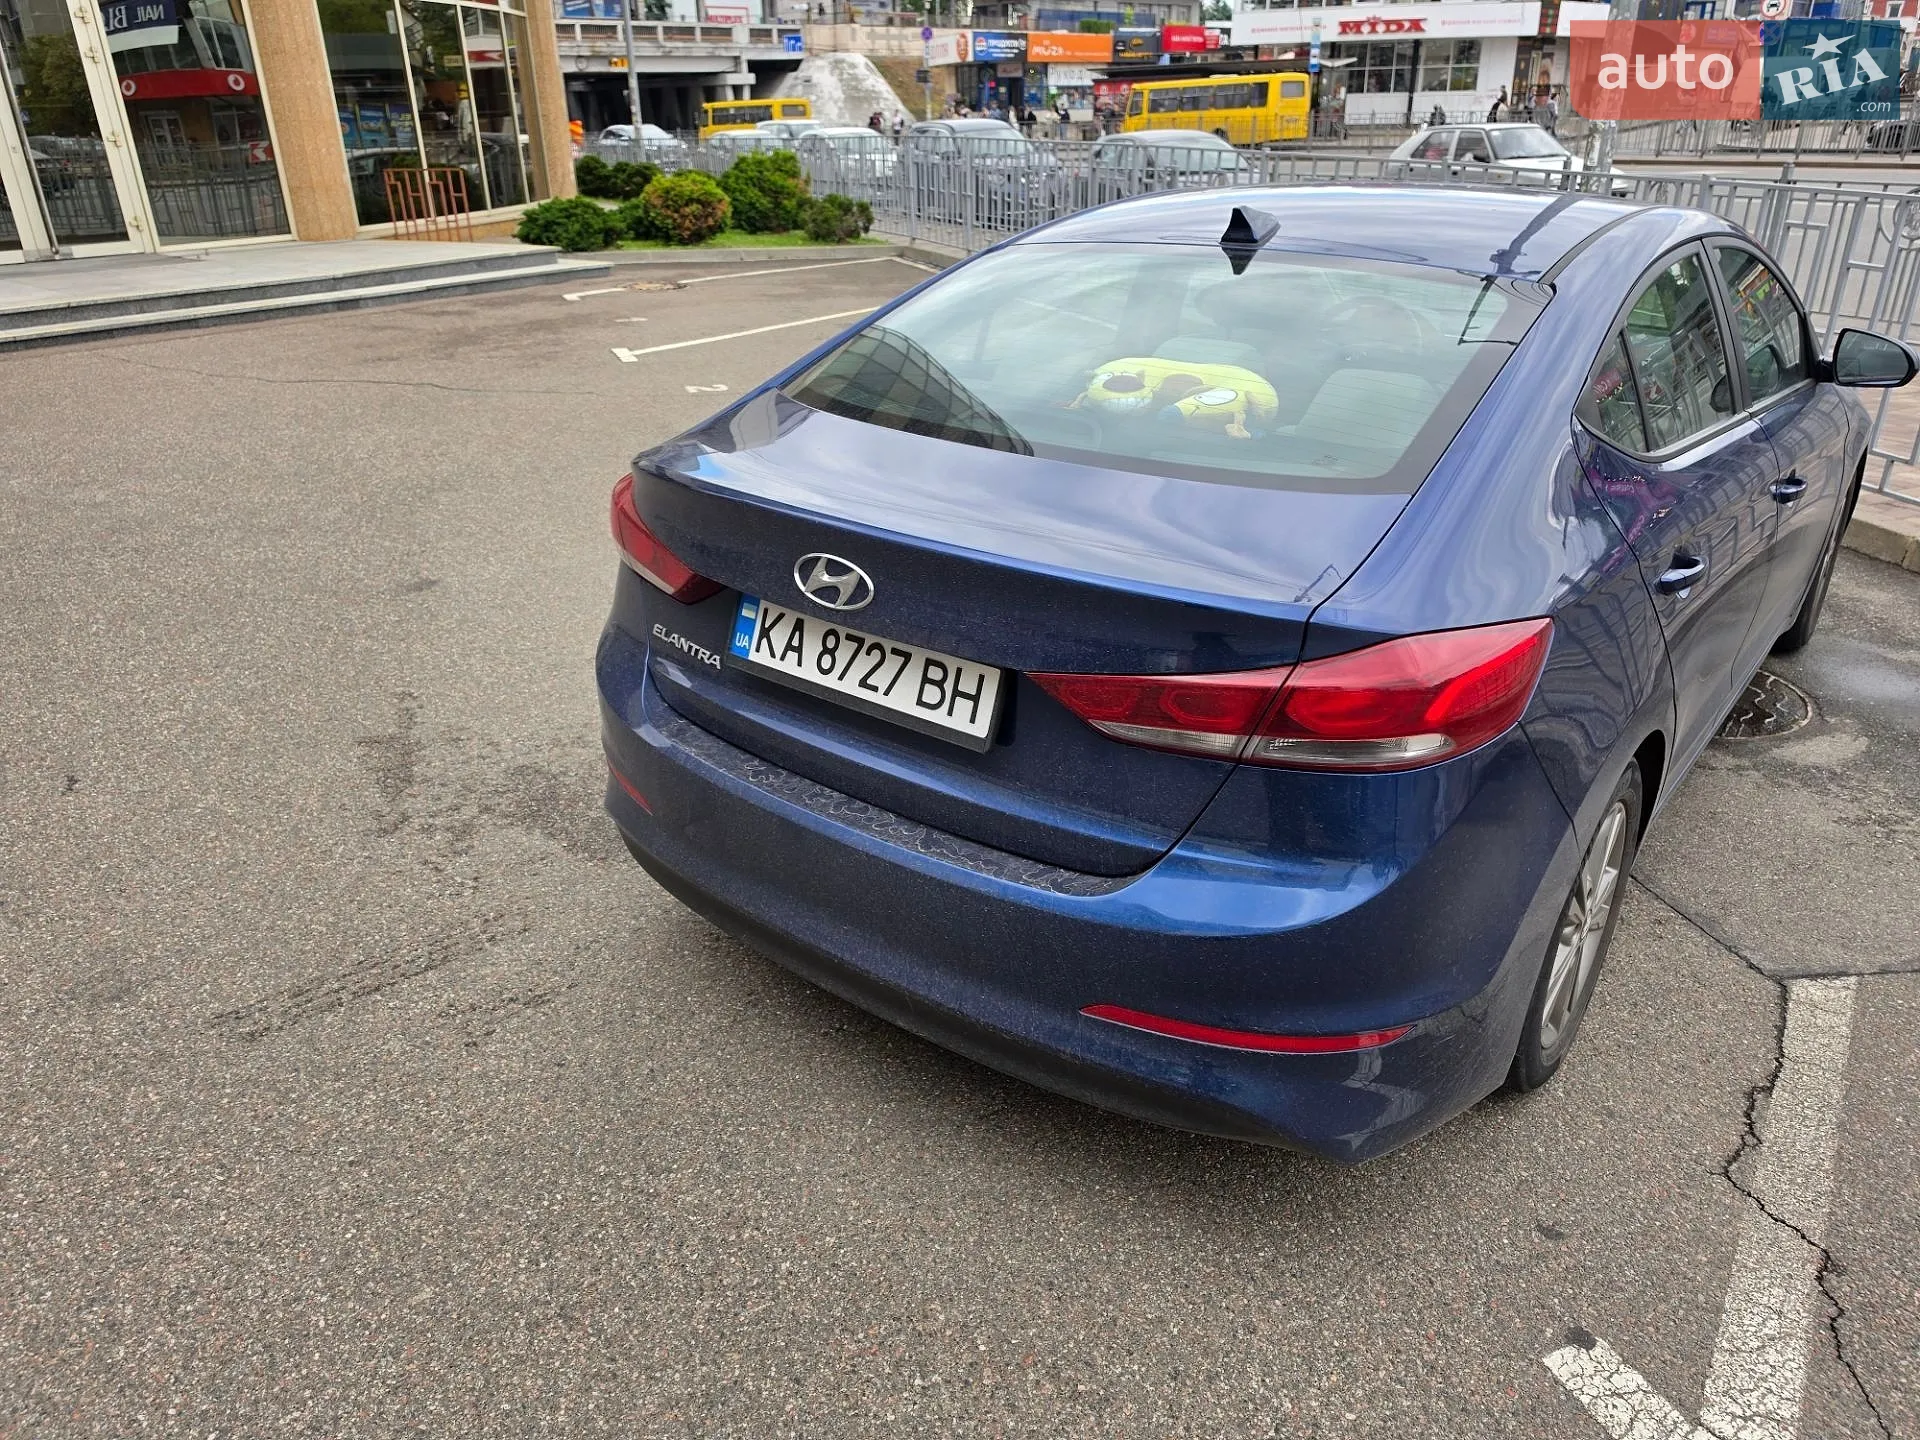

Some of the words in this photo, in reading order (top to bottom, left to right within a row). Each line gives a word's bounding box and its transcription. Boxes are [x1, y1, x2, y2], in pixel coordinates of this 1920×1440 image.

[1338, 18, 1427, 35] MIDA
[652, 623, 721, 669] ELANTRA
[735, 632, 749, 649] UA
[755, 607, 804, 667] KA
[816, 628, 912, 697] 8727
[915, 658, 985, 724] BH
